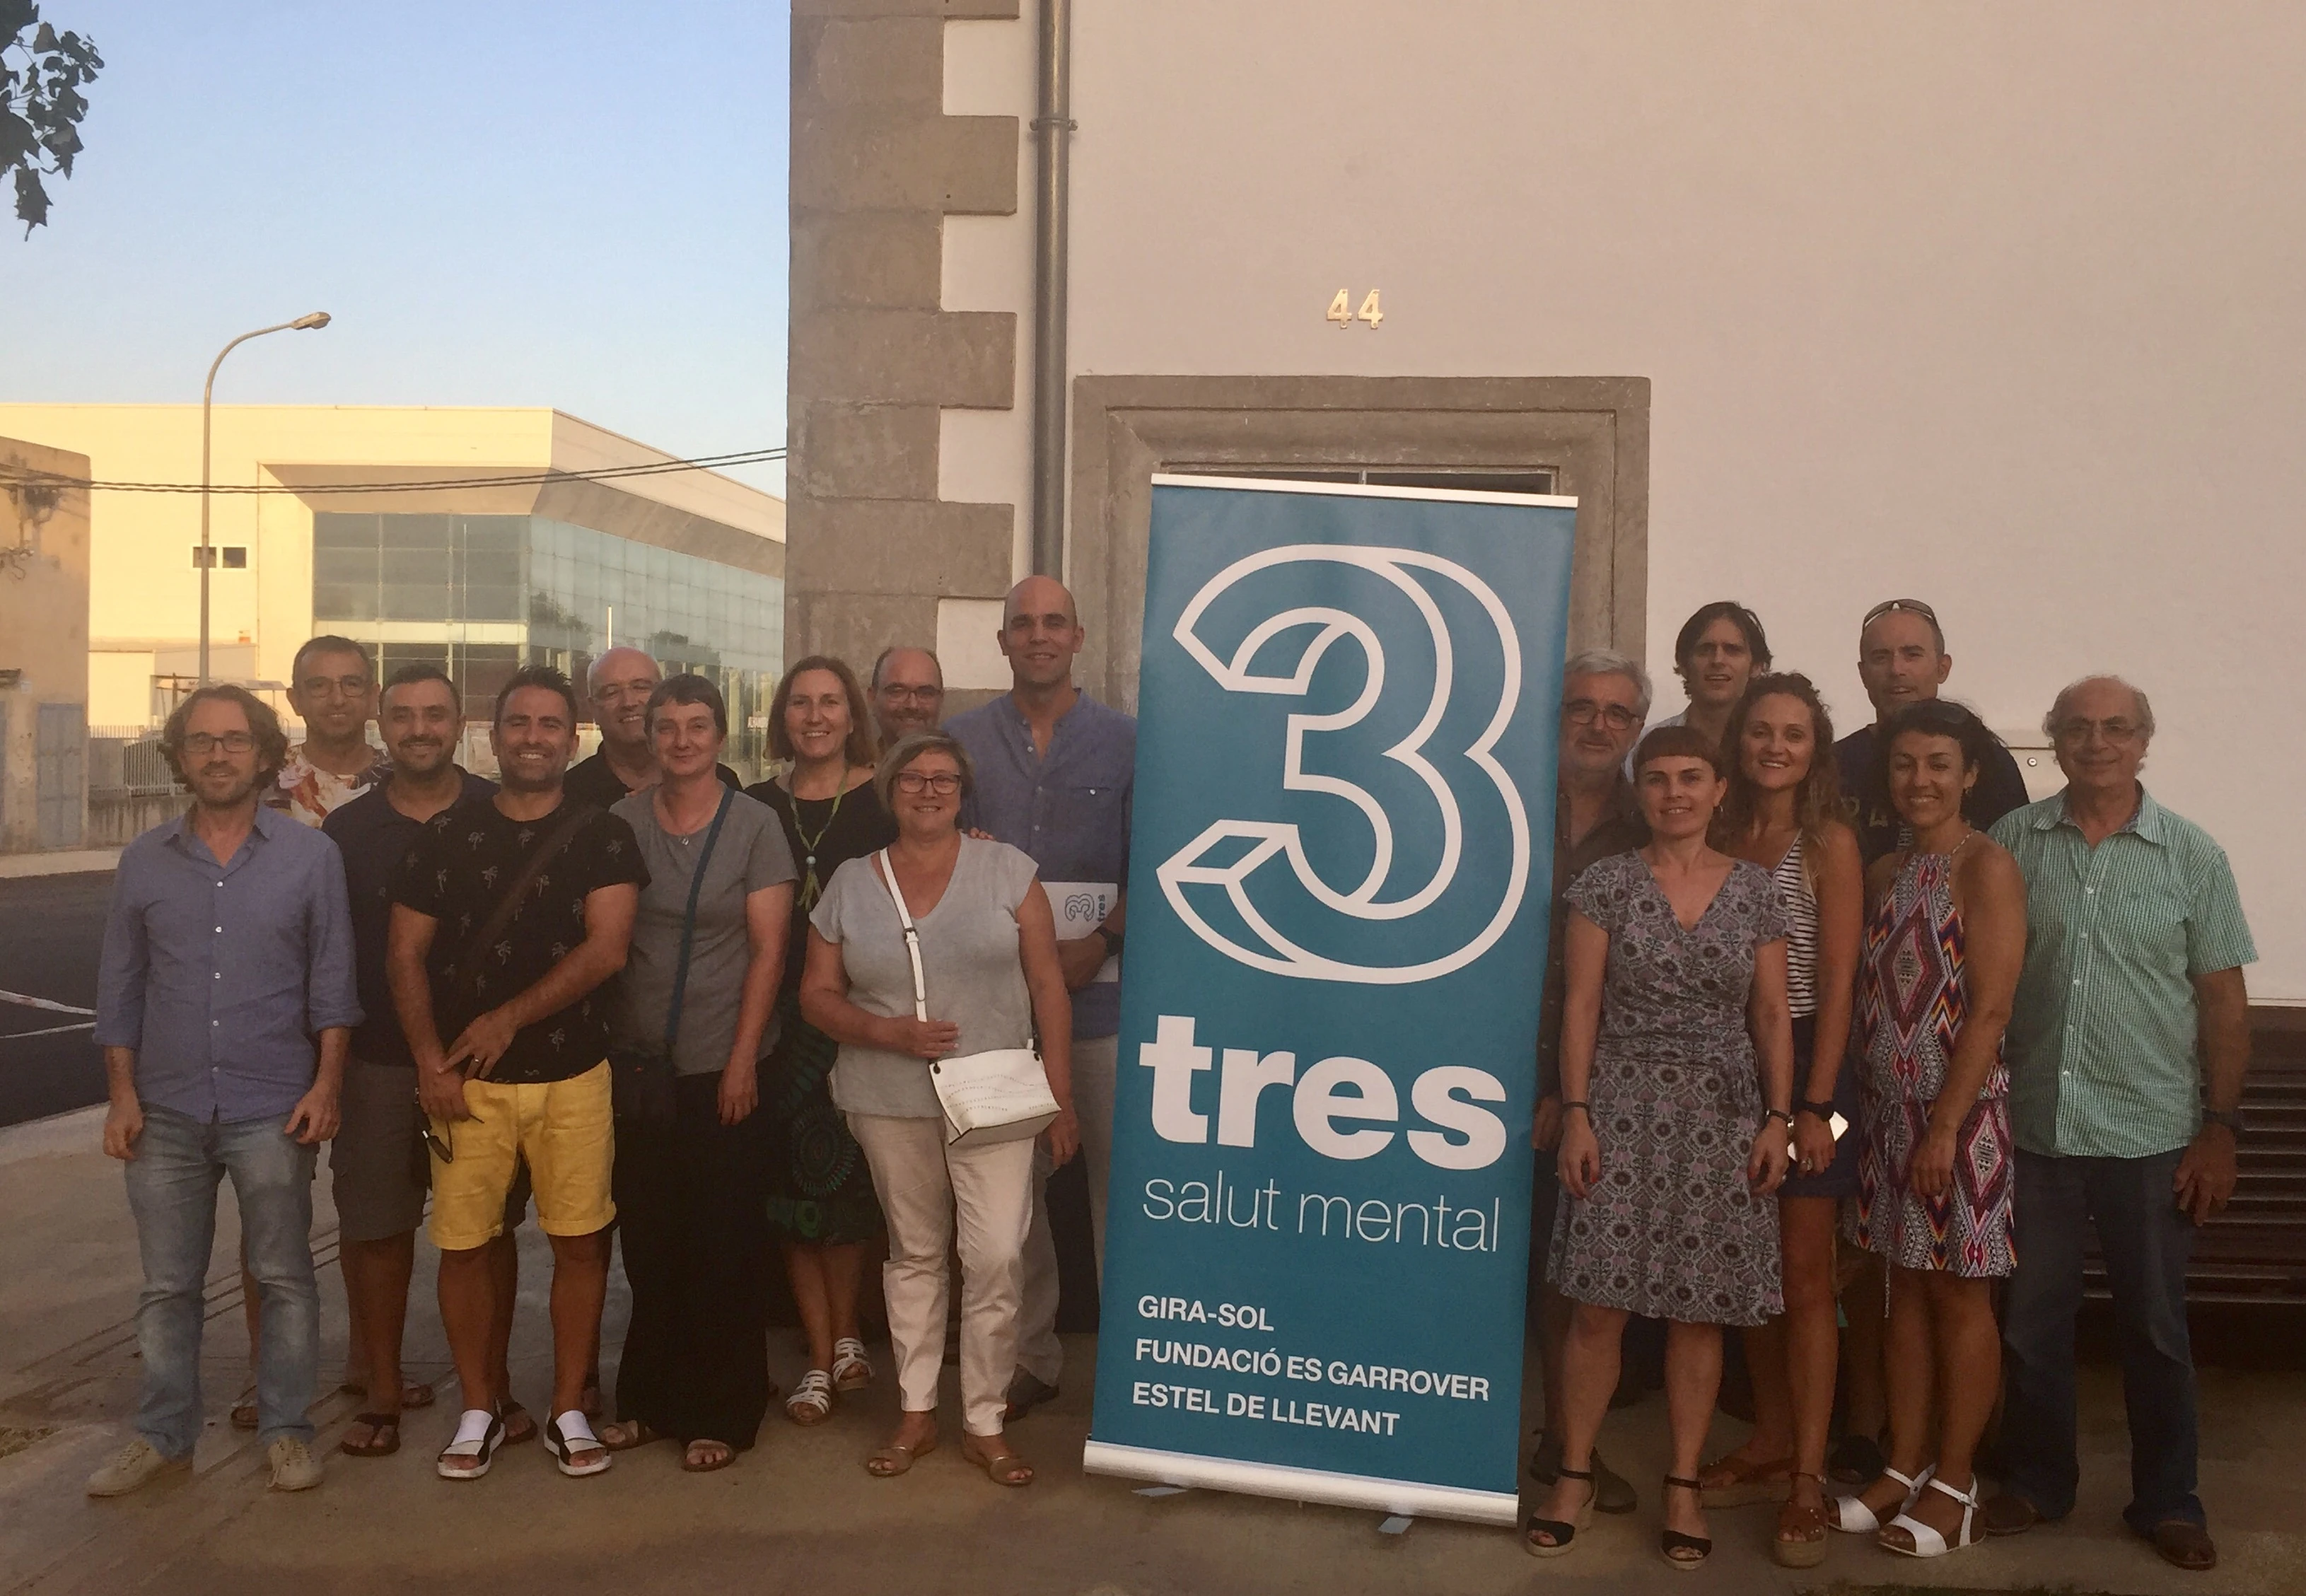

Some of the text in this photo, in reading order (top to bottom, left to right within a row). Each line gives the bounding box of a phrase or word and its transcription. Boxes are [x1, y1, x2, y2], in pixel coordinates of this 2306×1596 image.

[1327, 288, 1384, 330] 44
[1156, 543, 1531, 985] 3
[1139, 1014, 1507, 1170] tres
[1143, 1170, 1499, 1252] salut mental
[1137, 1295, 1274, 1332] GIRA-SOL
[1136, 1338, 1489, 1402] FUNDACIÓ ES GARROVER
[1133, 1382, 1400, 1435] ESTEL DE LLEVANT
